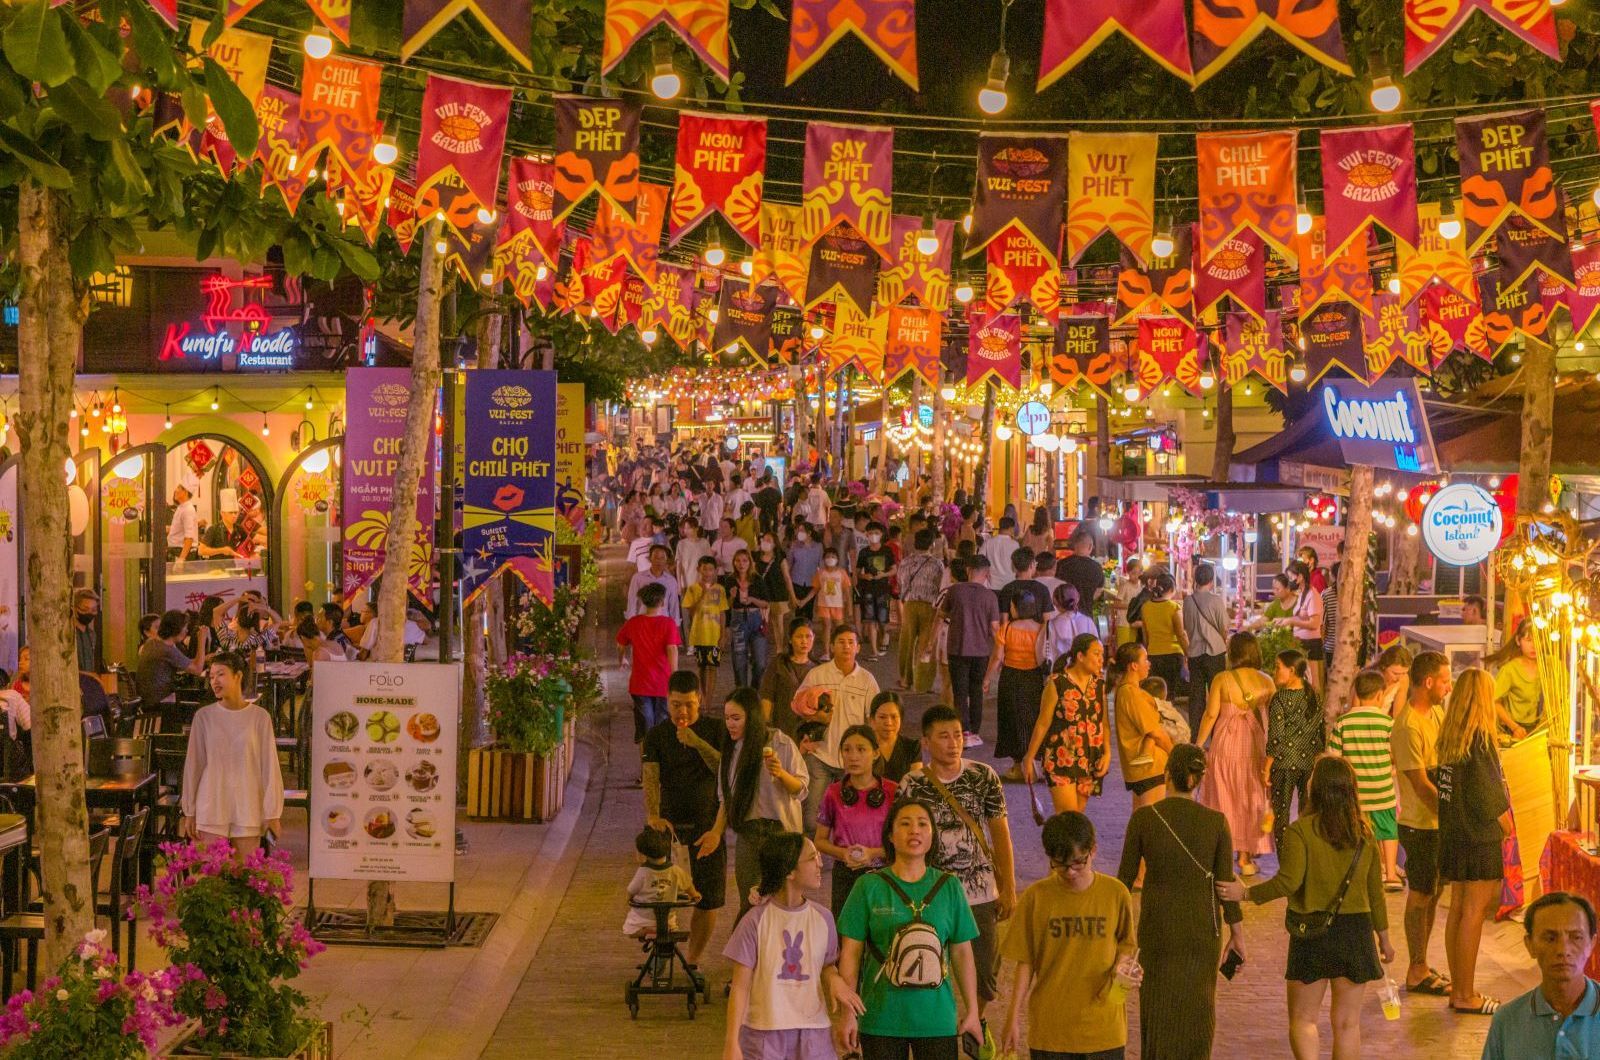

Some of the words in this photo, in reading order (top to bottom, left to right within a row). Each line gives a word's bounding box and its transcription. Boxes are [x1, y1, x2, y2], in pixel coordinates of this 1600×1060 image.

[322, 65, 362, 86] CHILL
[262, 97, 289, 116] SAY
[434, 103, 493, 129] VUI-FEST
[578, 106, 621, 130] ĐẸP
[431, 131, 483, 154] BAZAAR
[575, 128, 626, 152] PHẾT
[699, 132, 744, 150] NGON
[1481, 124, 1526, 149] ĐẸP
[831, 139, 868, 161] SAY
[1219, 142, 1268, 164] CHILL
[1479, 145, 1535, 173] PHẾT
[693, 149, 746, 173] PHẾT
[1087, 153, 1128, 174] VUI
[1337, 149, 1404, 171] VUI-FEST
[517, 179, 555, 198] VUI-FES
[987, 177, 1052, 193] VUI-FEST
[1341, 180, 1400, 203] BAZAAR
[768, 216, 796, 235] VUI
[820, 249, 868, 266] VUI-FEST
[659, 272, 680, 287] SAY
[1207, 264, 1251, 281] BAZAAR
[1380, 303, 1404, 319] SAY
[901, 315, 929, 328] CHILL
[159, 322, 233, 361] Kungfu
[237, 331, 295, 354] Noodle
[1153, 327, 1182, 338] NGON
[1311, 330, 1351, 344] VUI-FEST
[240, 353, 293, 367] Restaurant
[977, 347, 1012, 361] BAZAAR
[368, 407, 407, 418] VUI-FES
[489, 409, 534, 419] VUI-FEST
[1324, 386, 1415, 443] Coconut
[491, 436, 529, 460] CHỢ
[351, 459, 384, 477] VUI
[469, 459, 508, 477] CHILL
[511, 459, 551, 478] PHẾT
[109, 497, 130, 508] 40K
[1432, 508, 1494, 527] Coconut
[1303, 531, 1341, 542] Yakult
[346, 561, 375, 572] SHOW
[356, 696, 415, 706] HOME-MADE
[1048, 915, 1107, 939] STATE
